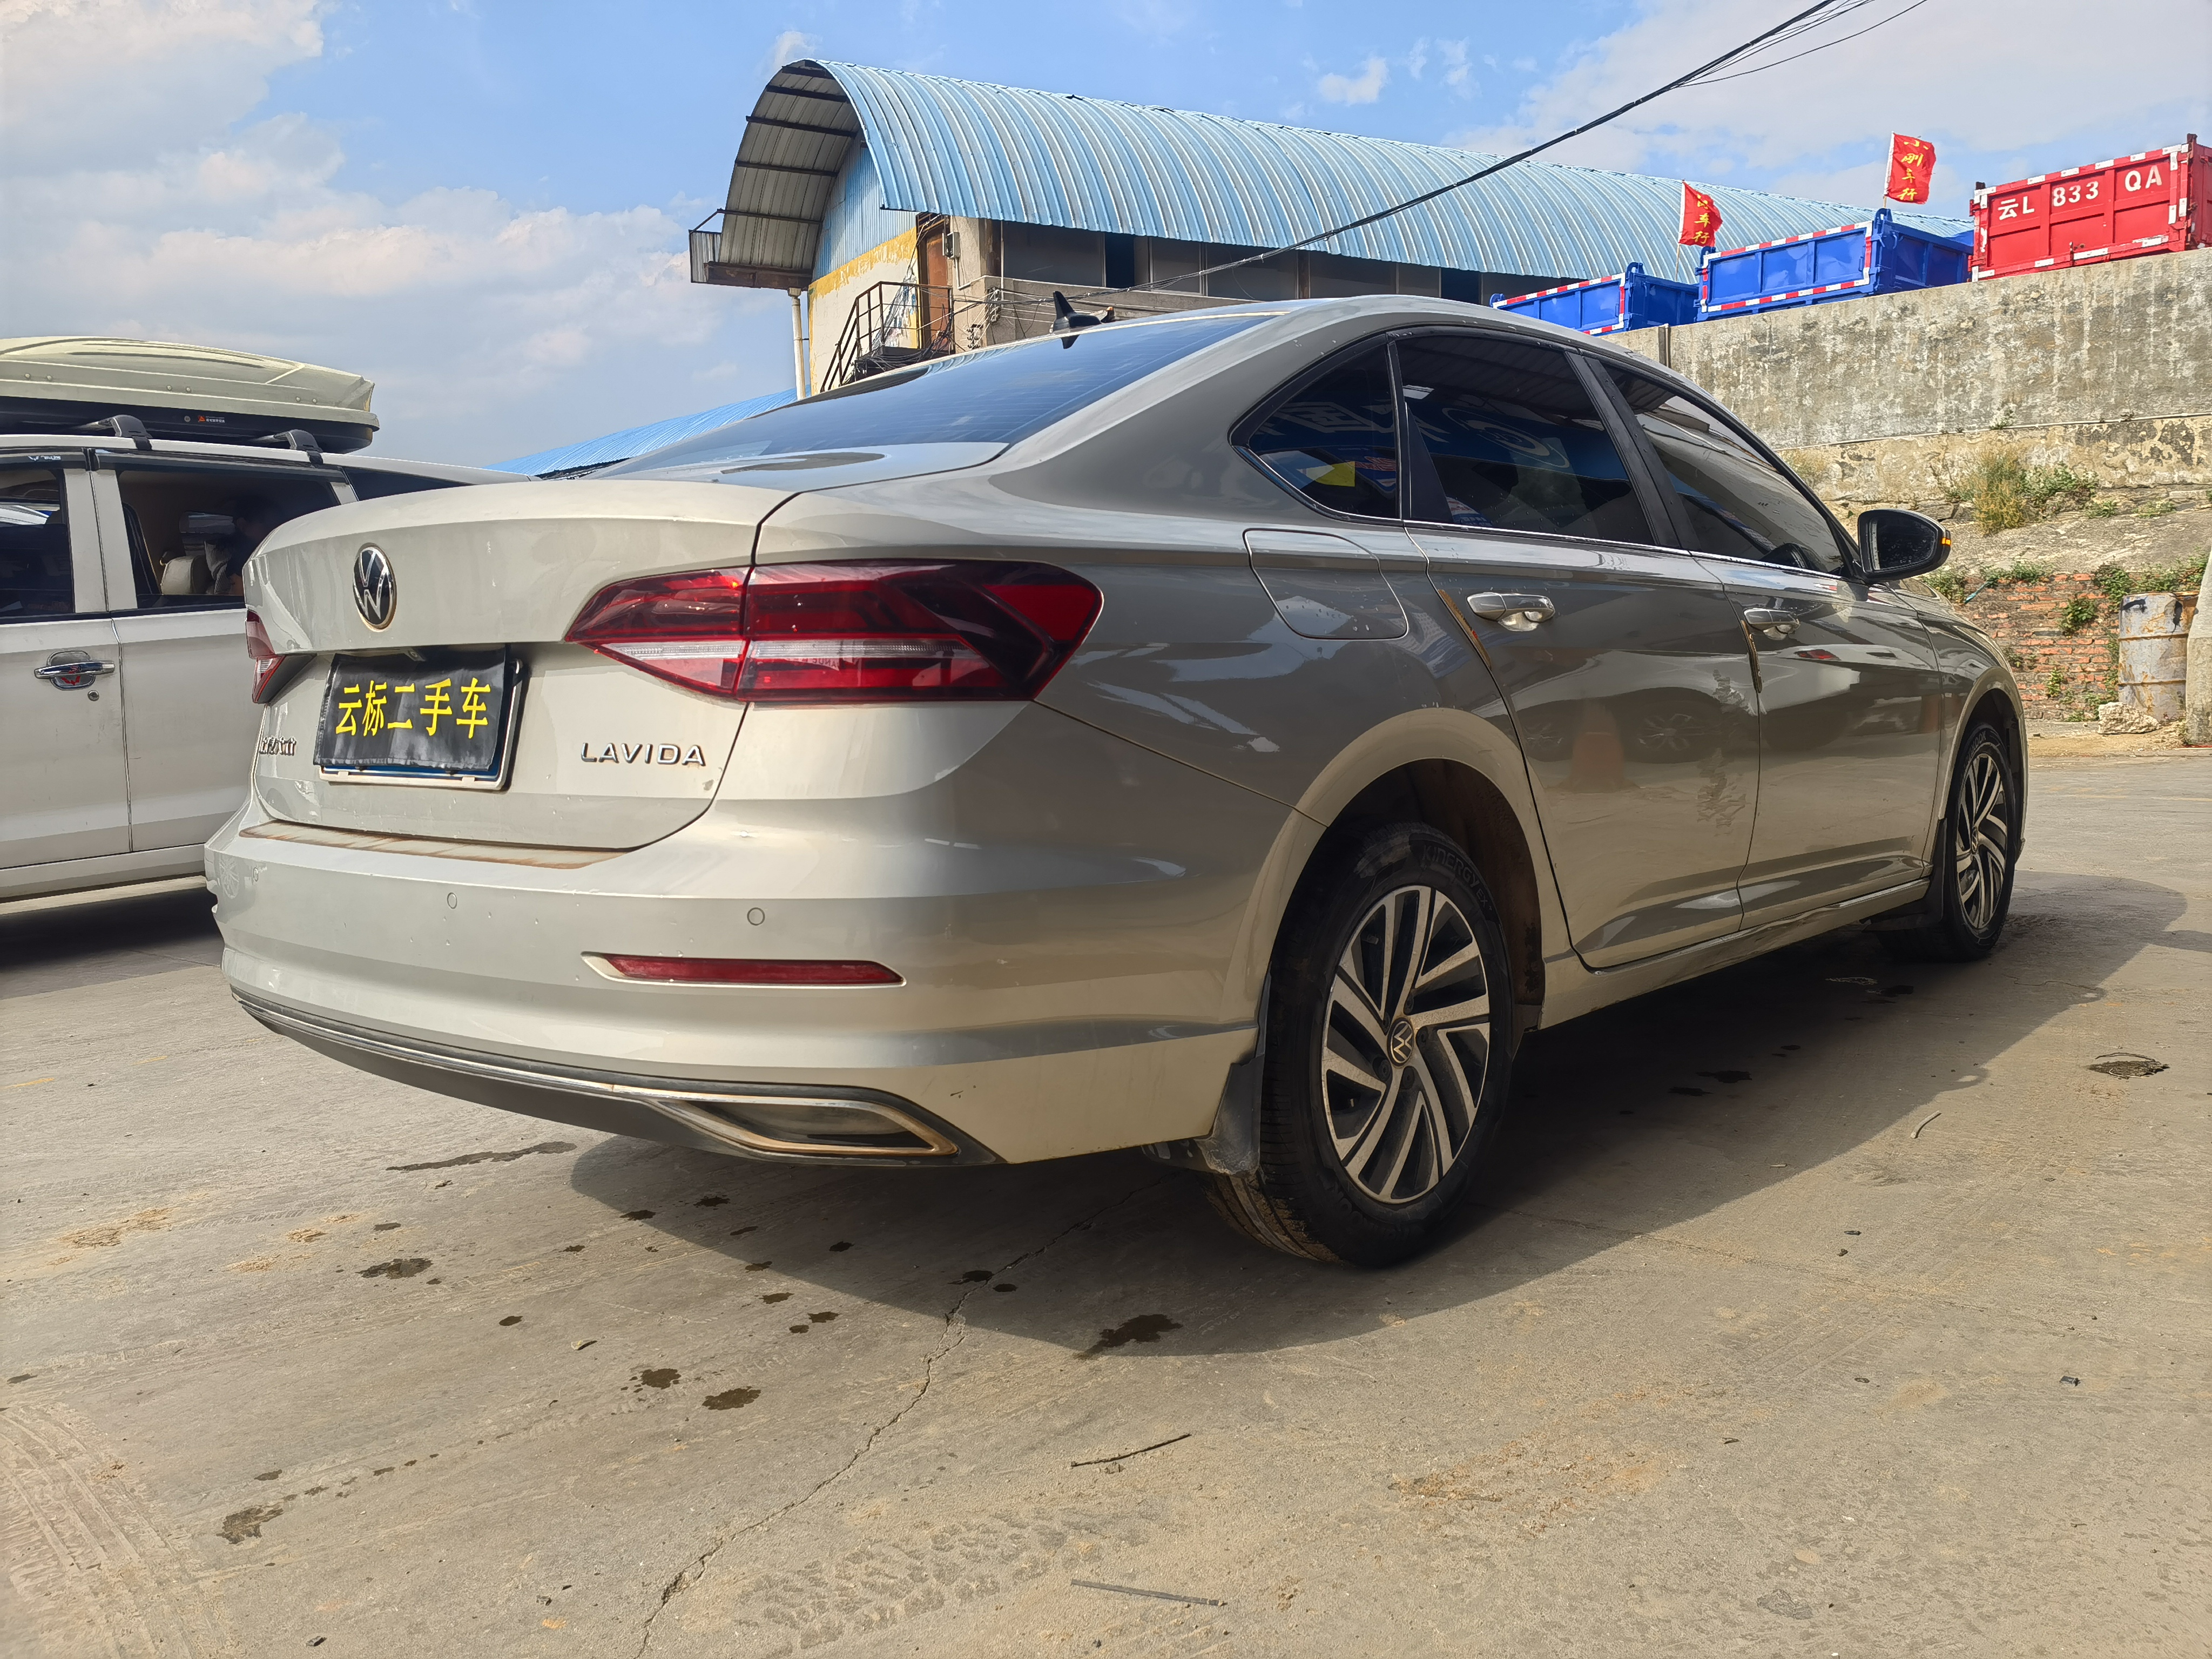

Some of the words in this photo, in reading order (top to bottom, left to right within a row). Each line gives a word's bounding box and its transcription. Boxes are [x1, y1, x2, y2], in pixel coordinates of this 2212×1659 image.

[1998, 195, 2034, 220] 云L
[2053, 181, 2099, 206] 833
[2125, 165, 2162, 191] QA
[336, 677, 491, 739] 云标二手车
[581, 742, 706, 766] LAVIDA
